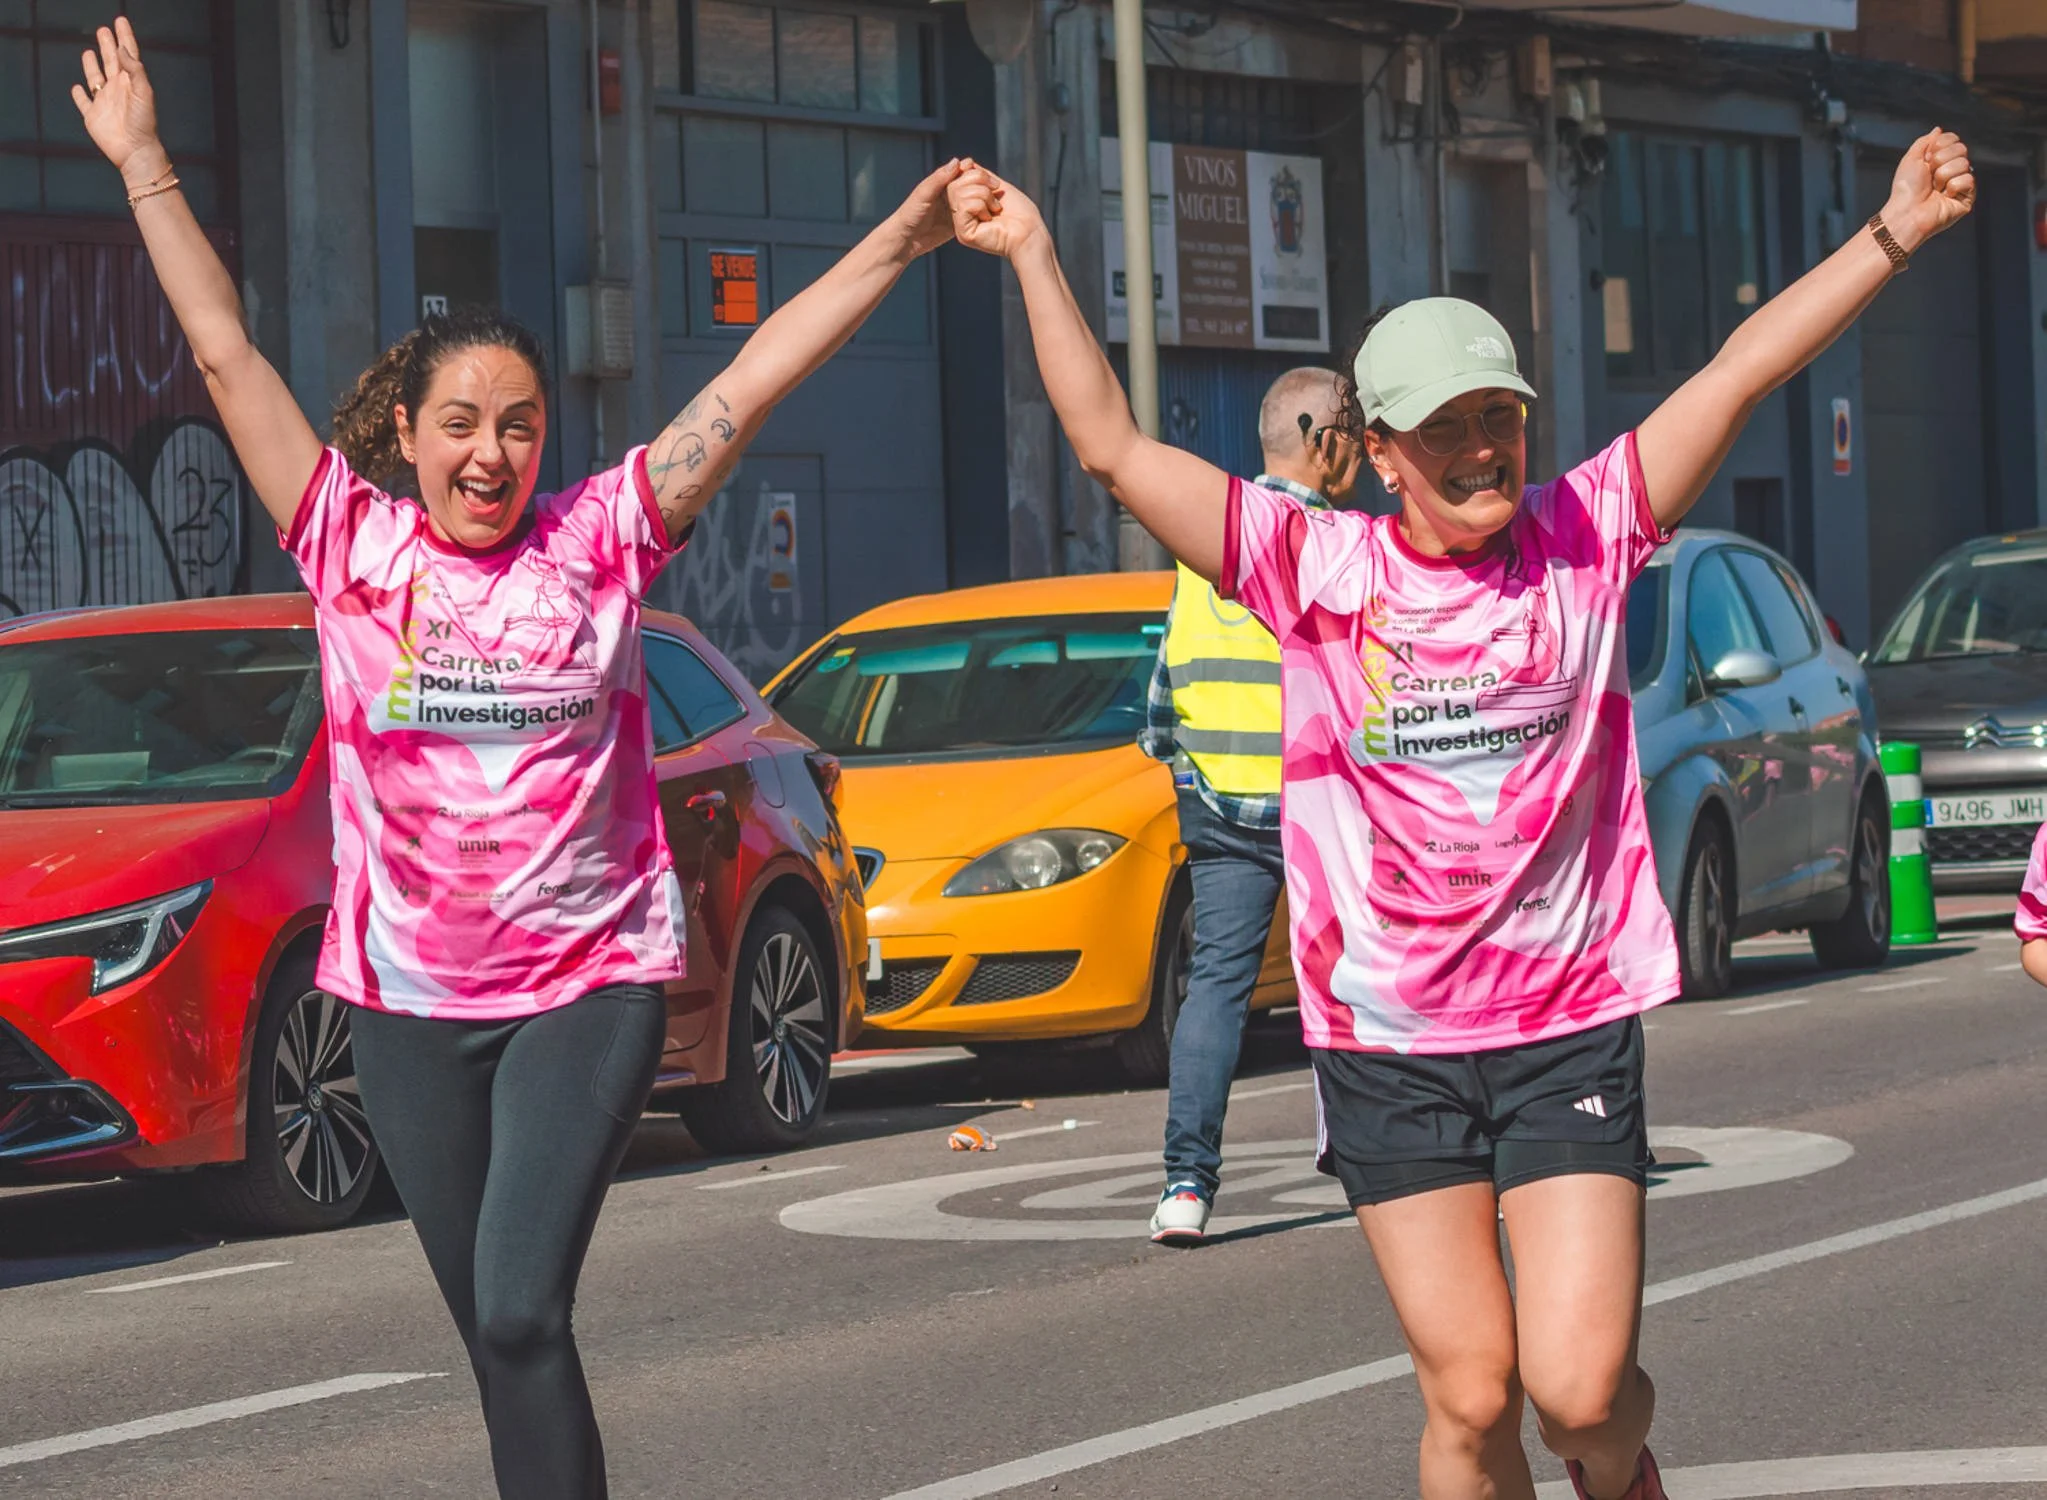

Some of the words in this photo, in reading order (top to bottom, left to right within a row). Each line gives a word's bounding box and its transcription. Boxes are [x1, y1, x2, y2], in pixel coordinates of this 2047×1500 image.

[1184, 155, 1237, 188] VINOS
[1177, 192, 1247, 225] MIGUEL
[425, 618, 451, 640] XI
[420, 646, 522, 675] Carrera
[419, 672, 465, 694] por
[471, 676, 496, 694] la
[1390, 671, 1498, 692] Carrera
[417, 695, 594, 730] Investigación
[1392, 704, 1438, 729] por
[1444, 699, 1472, 721] la
[1393, 710, 1571, 756] Investigación
[1938, 801, 1994, 822] 9496
[2003, 797, 2043, 819] JMH
[1453, 840, 1480, 854] Rioja
